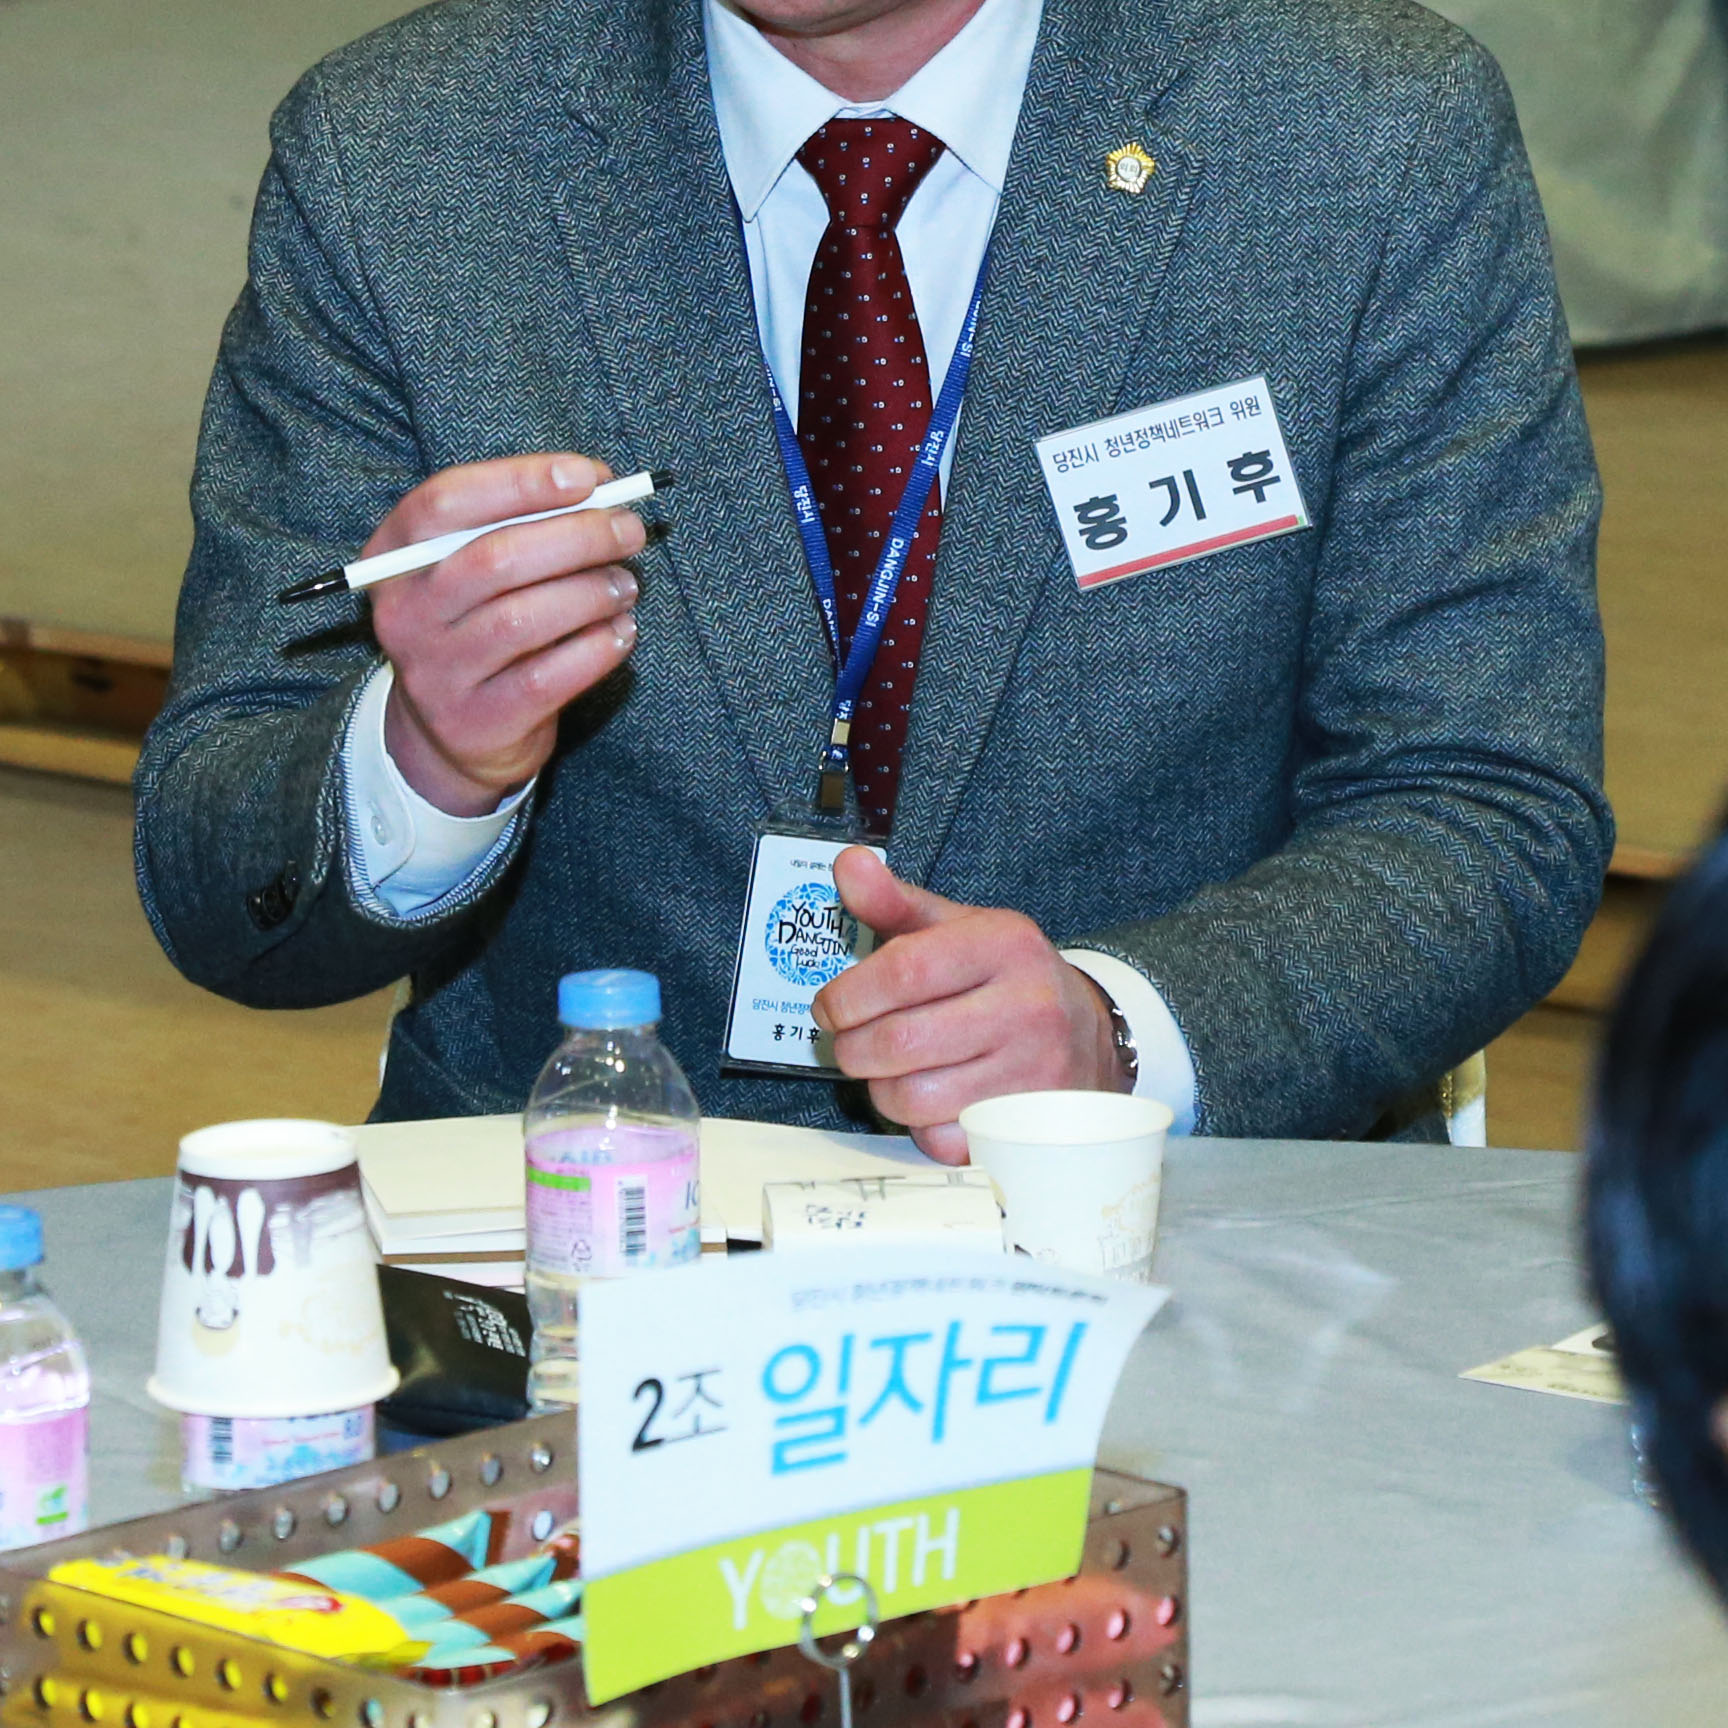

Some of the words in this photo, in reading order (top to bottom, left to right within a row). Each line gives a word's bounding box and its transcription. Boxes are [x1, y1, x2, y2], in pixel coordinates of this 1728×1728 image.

[1052, 442, 1101, 474] 당진시
[1104, 406, 1225, 458] 청년정책네트워크
[1229, 395, 1263, 421] 위원
[865, 537, 904, 628] DANGJIN-SI
[778, 919, 852, 957] DANGJIN
[791, 900, 845, 940] YOUTH
[631, 1369, 728, 1453] 2조
[760, 1320, 1090, 1476] 일자리
[718, 1507, 961, 1631] YOUTH
